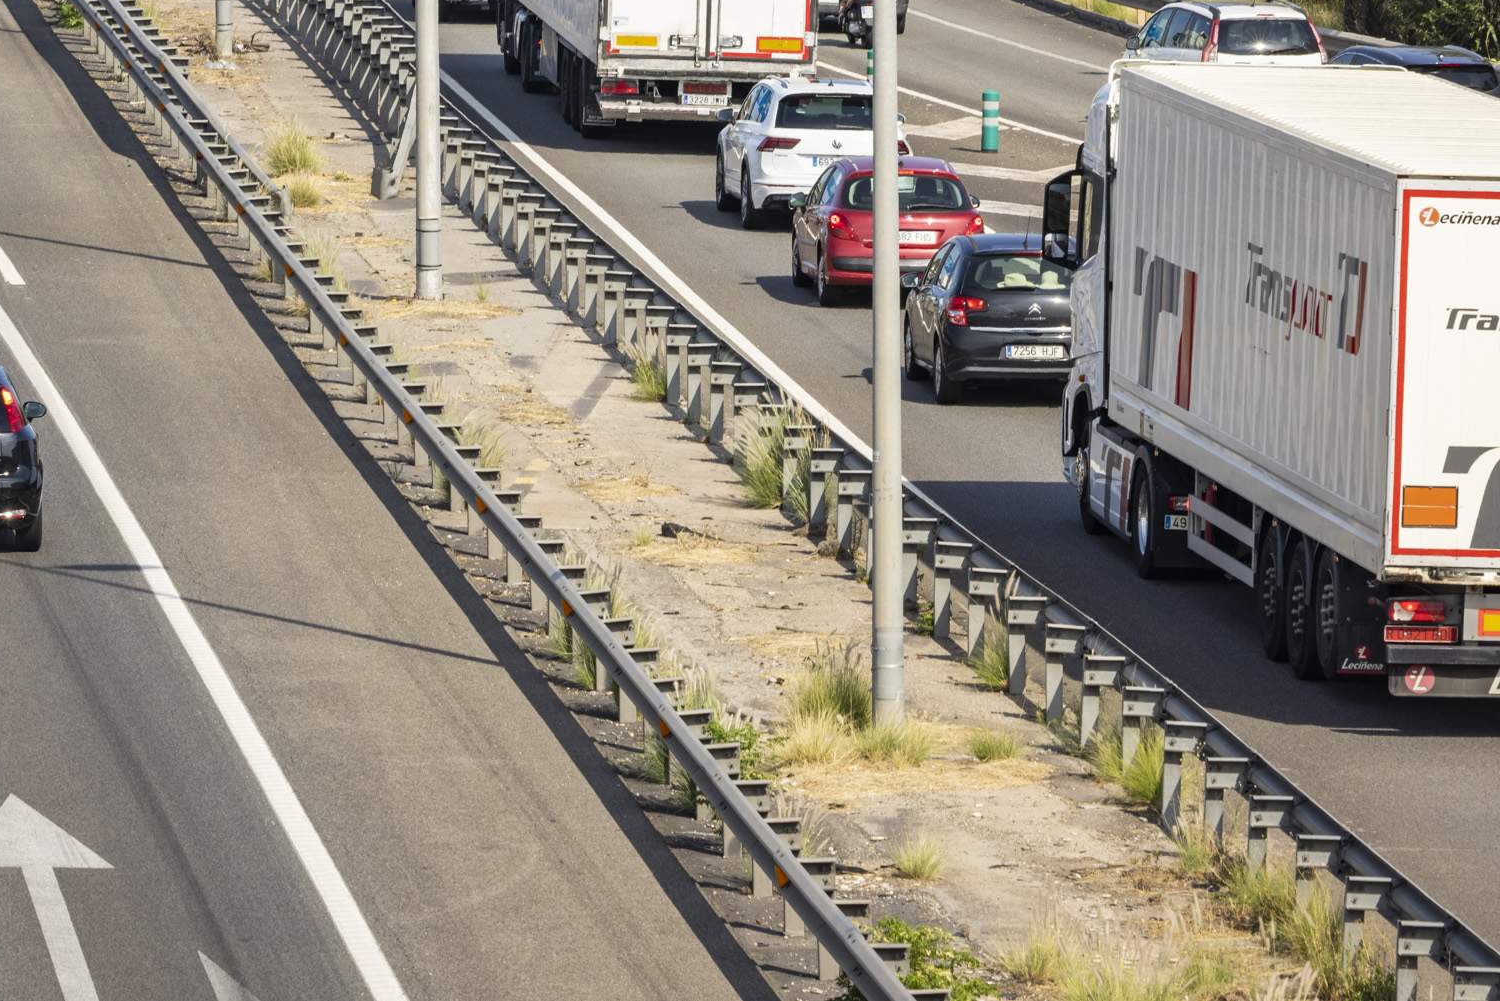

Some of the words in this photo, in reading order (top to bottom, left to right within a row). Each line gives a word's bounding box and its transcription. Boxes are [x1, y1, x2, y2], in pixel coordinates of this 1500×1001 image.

[1446, 308, 1500, 331] Tra
[1013, 348, 1036, 356] 7256
[1042, 348, 1059, 356] HJF
